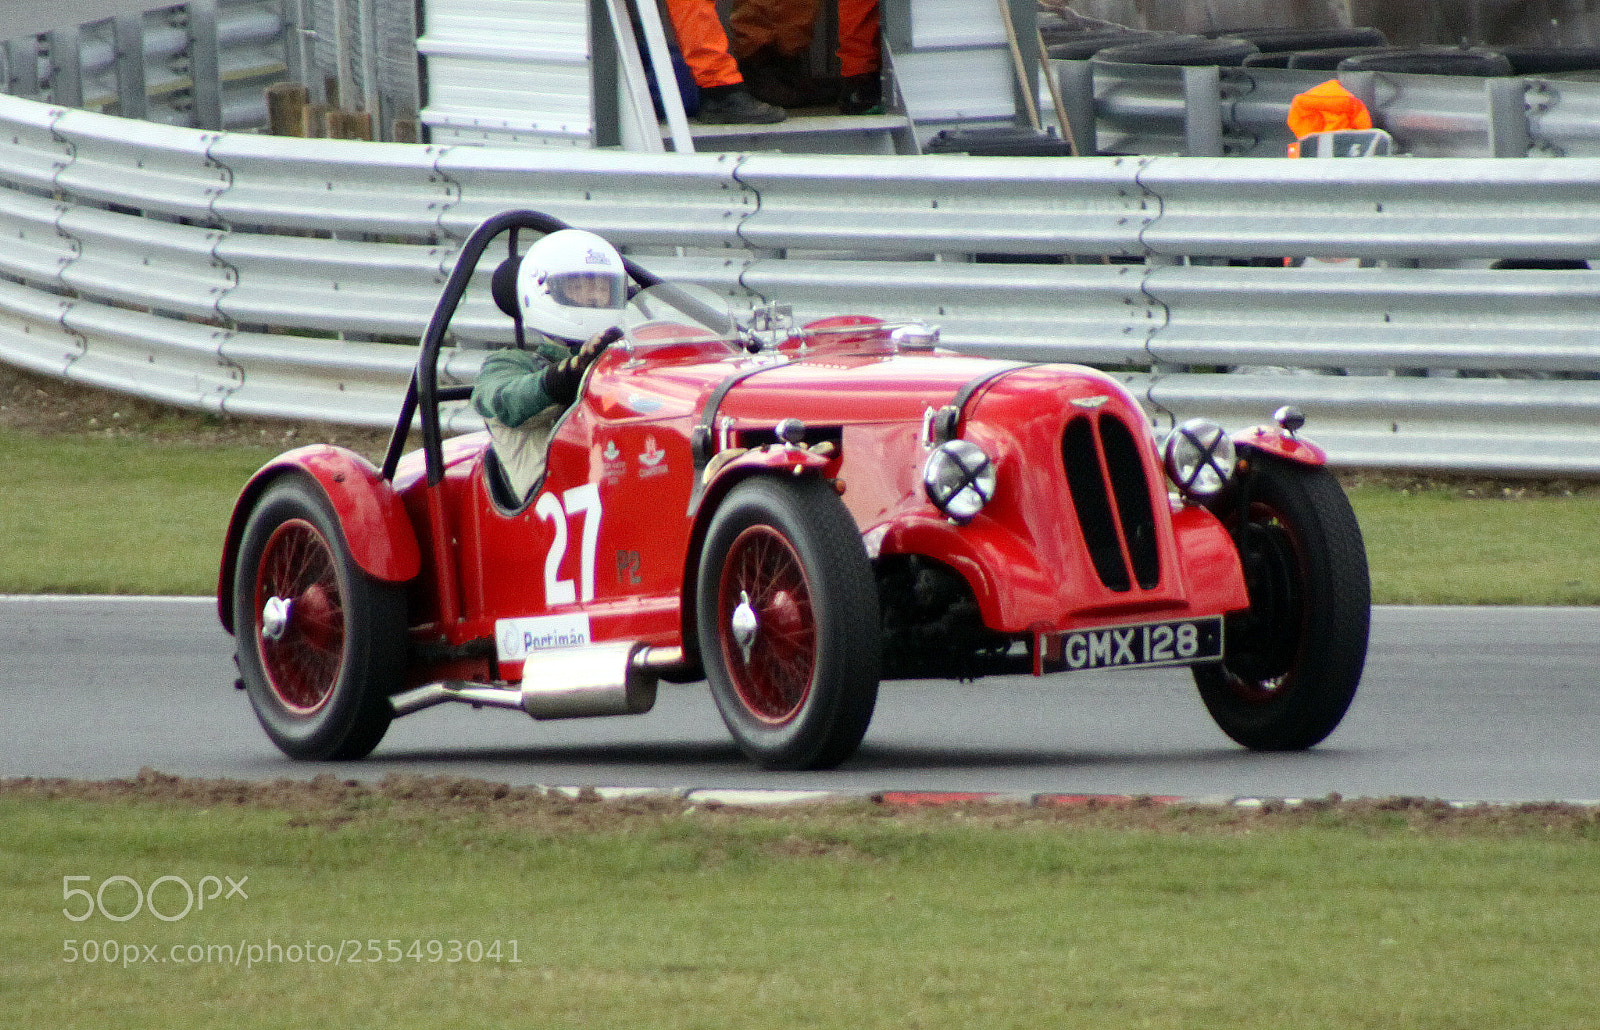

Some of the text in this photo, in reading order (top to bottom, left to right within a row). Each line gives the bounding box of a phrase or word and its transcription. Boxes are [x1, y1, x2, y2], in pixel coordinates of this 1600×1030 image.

[535, 482, 603, 606] 27
[616, 549, 642, 584] P2
[1065, 623, 1199, 668] GMX 128
